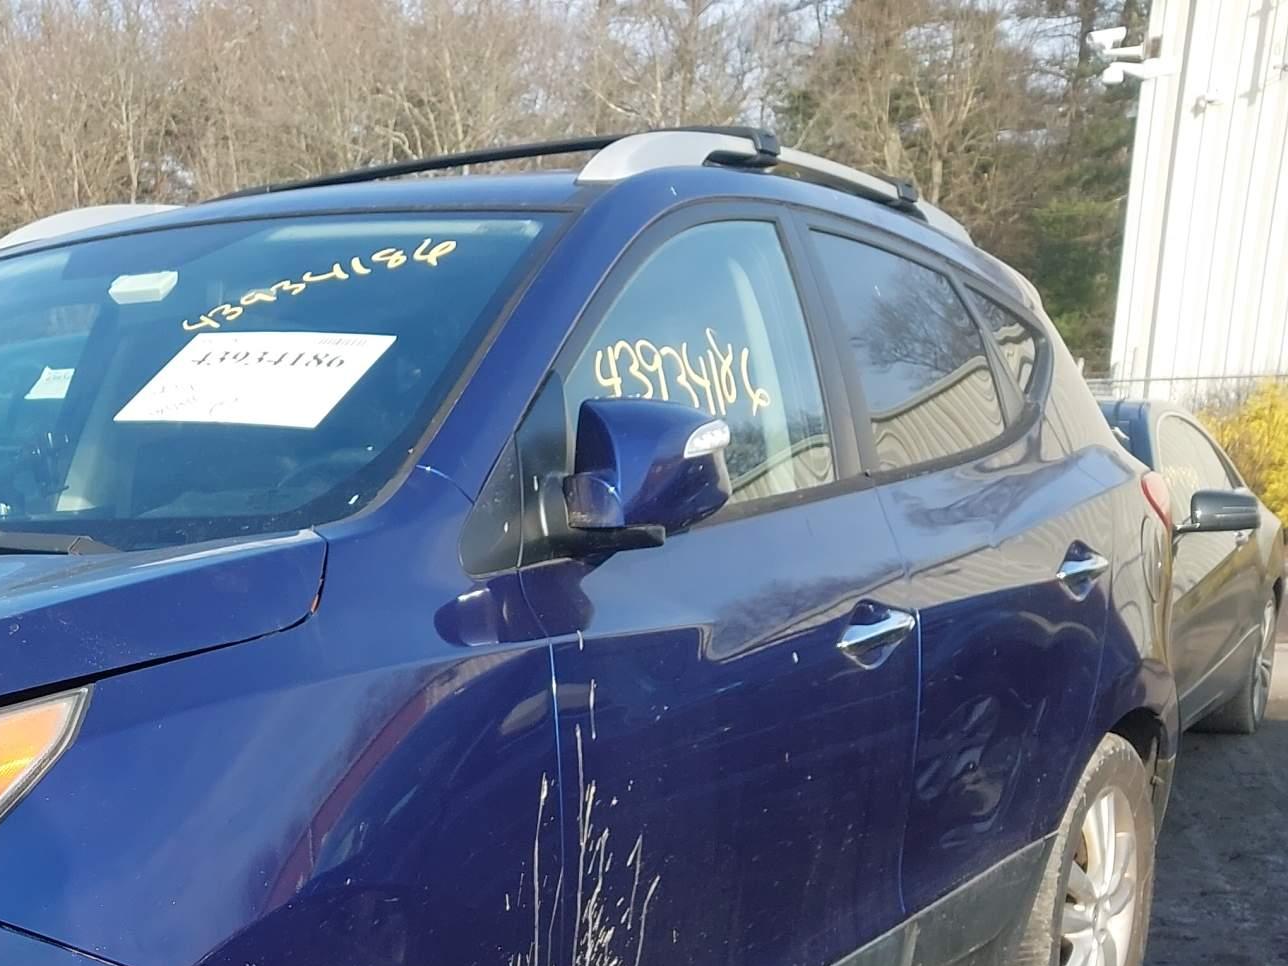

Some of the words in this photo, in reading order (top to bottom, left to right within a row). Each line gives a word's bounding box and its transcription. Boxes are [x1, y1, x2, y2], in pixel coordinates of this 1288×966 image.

[182, 238, 457, 330] 43934186
[191, 351, 346, 368] 43934186
[595, 327, 771, 416] 43934186
